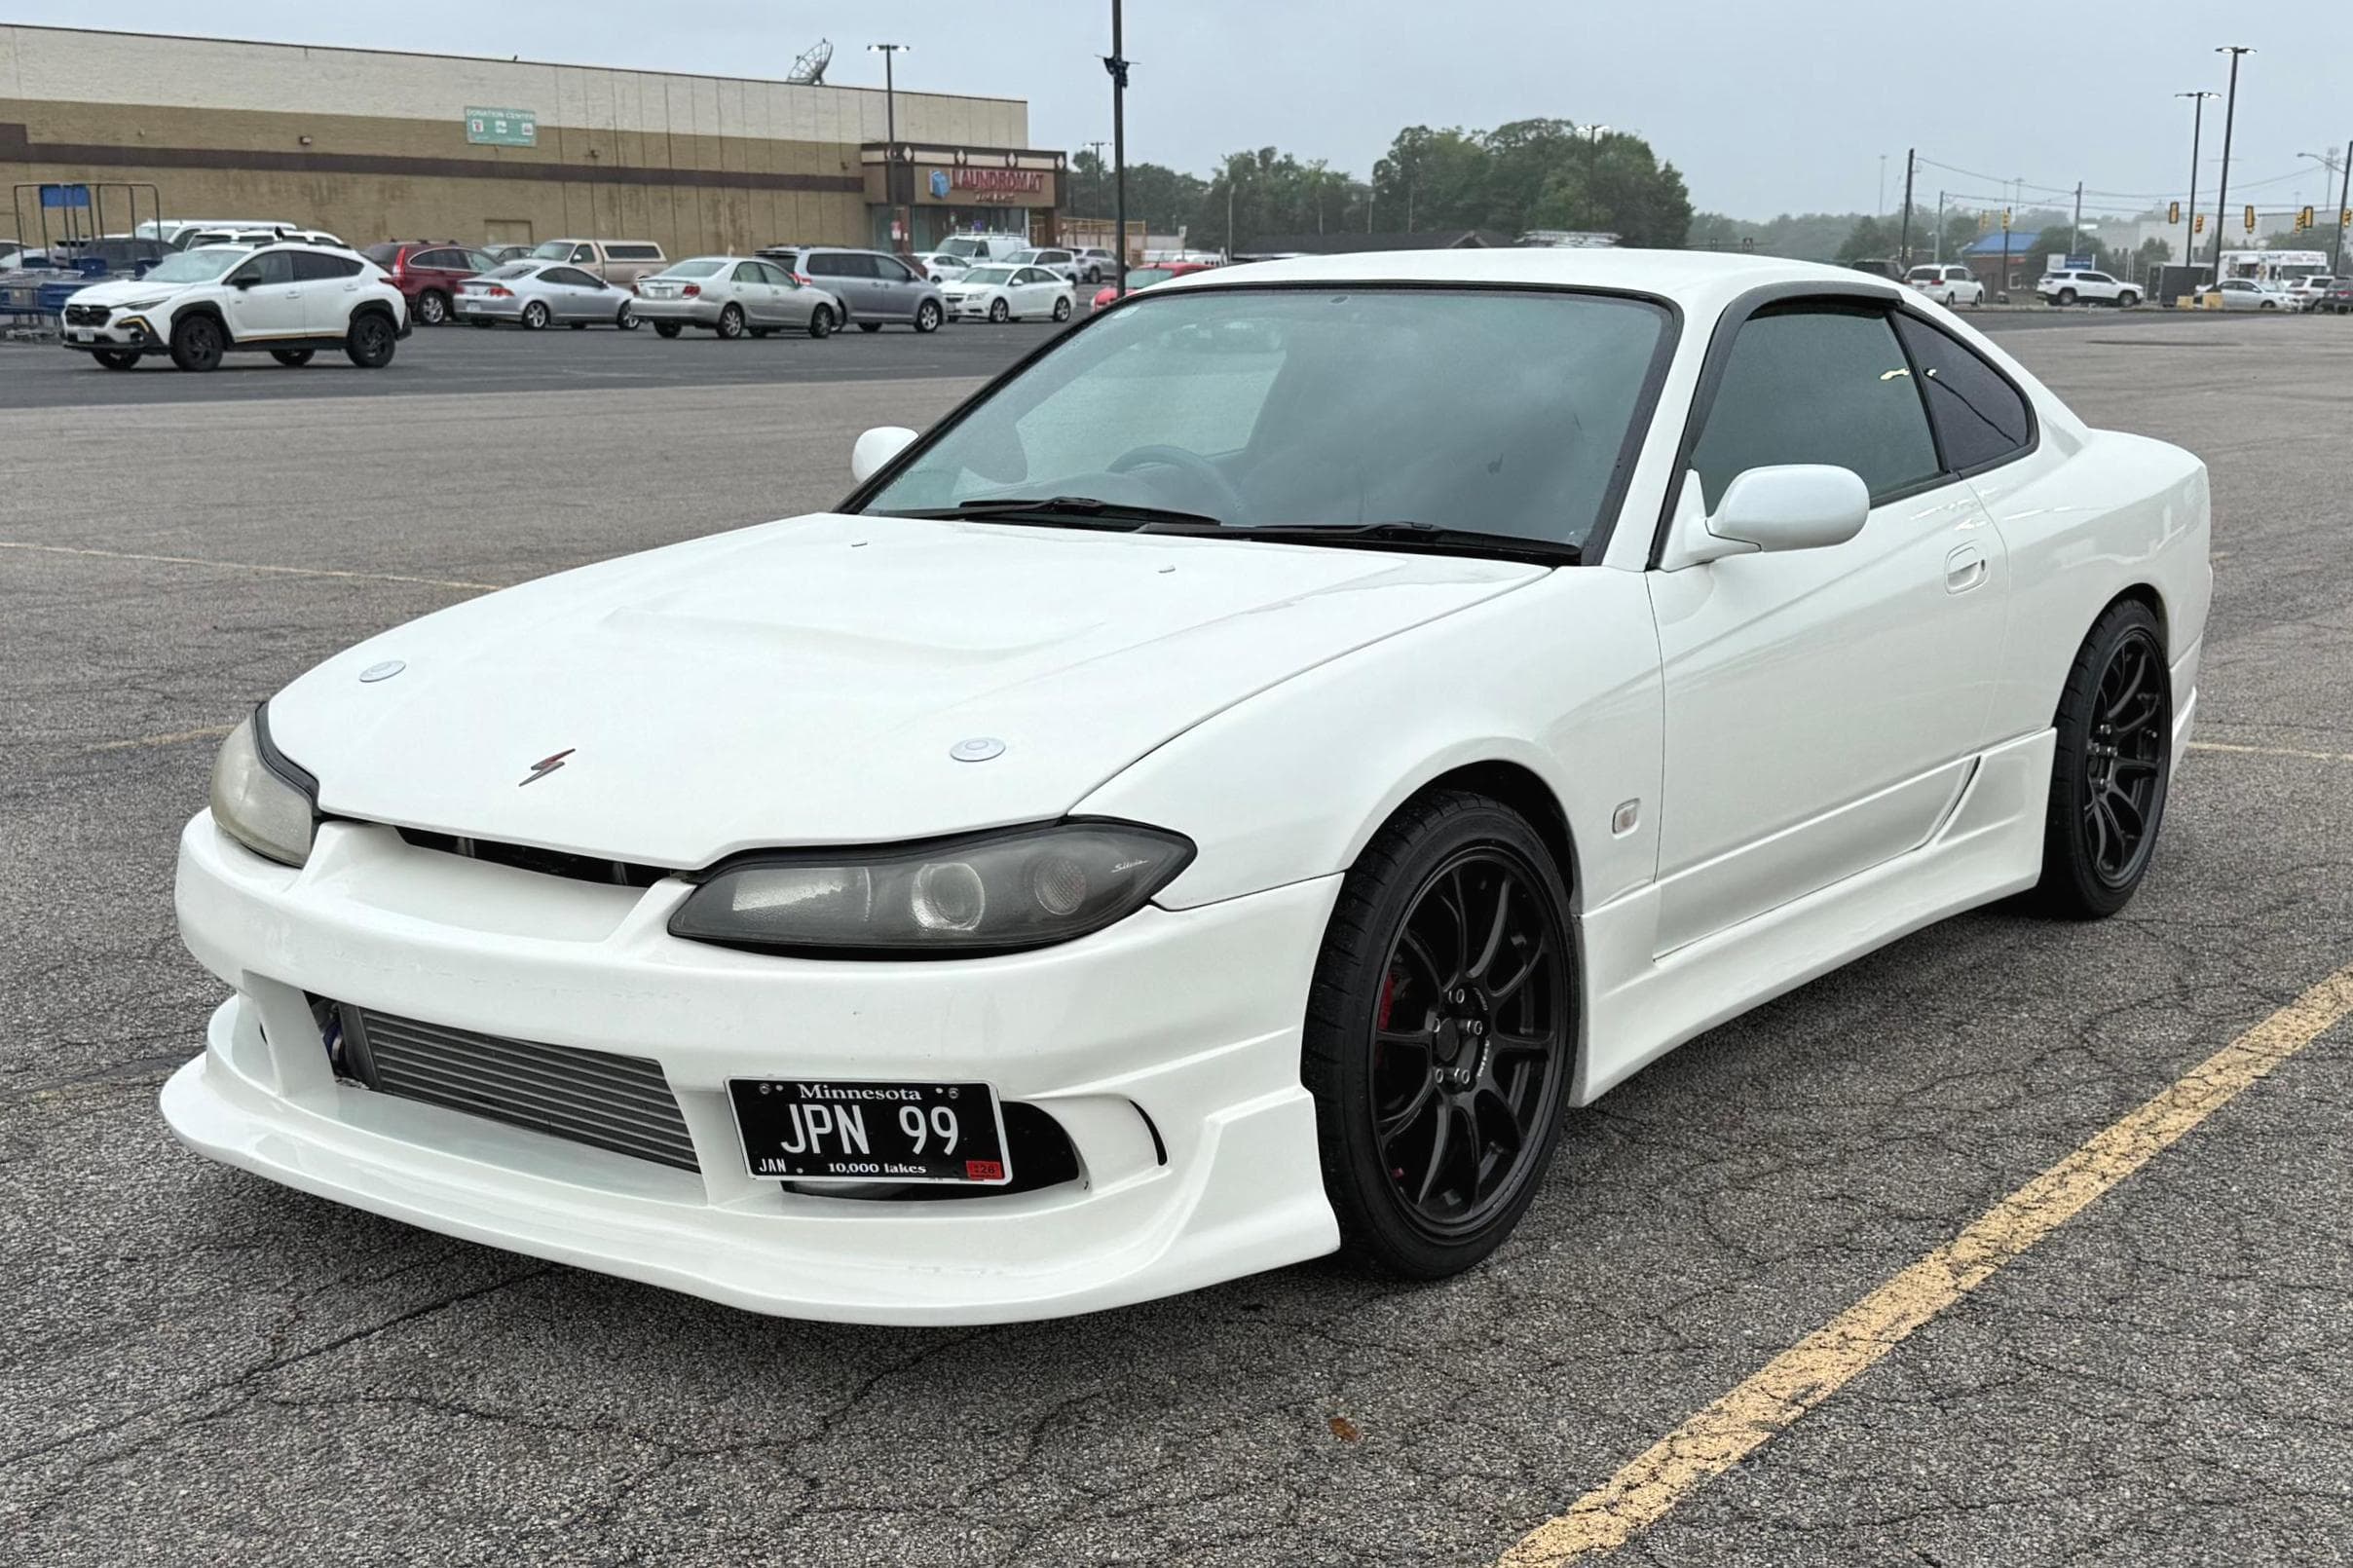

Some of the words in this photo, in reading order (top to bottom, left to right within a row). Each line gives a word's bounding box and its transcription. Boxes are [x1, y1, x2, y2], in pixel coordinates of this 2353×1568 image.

[951, 169, 1044, 193] LAUNDROMAT
[798, 1084, 923, 1101] Minnesota
[780, 1103, 871, 1155] JPN
[899, 1105, 959, 1156] 99
[759, 1158, 787, 1174] JAN
[827, 1162, 878, 1174] 10,000
[884, 1162, 927, 1175] lakes
